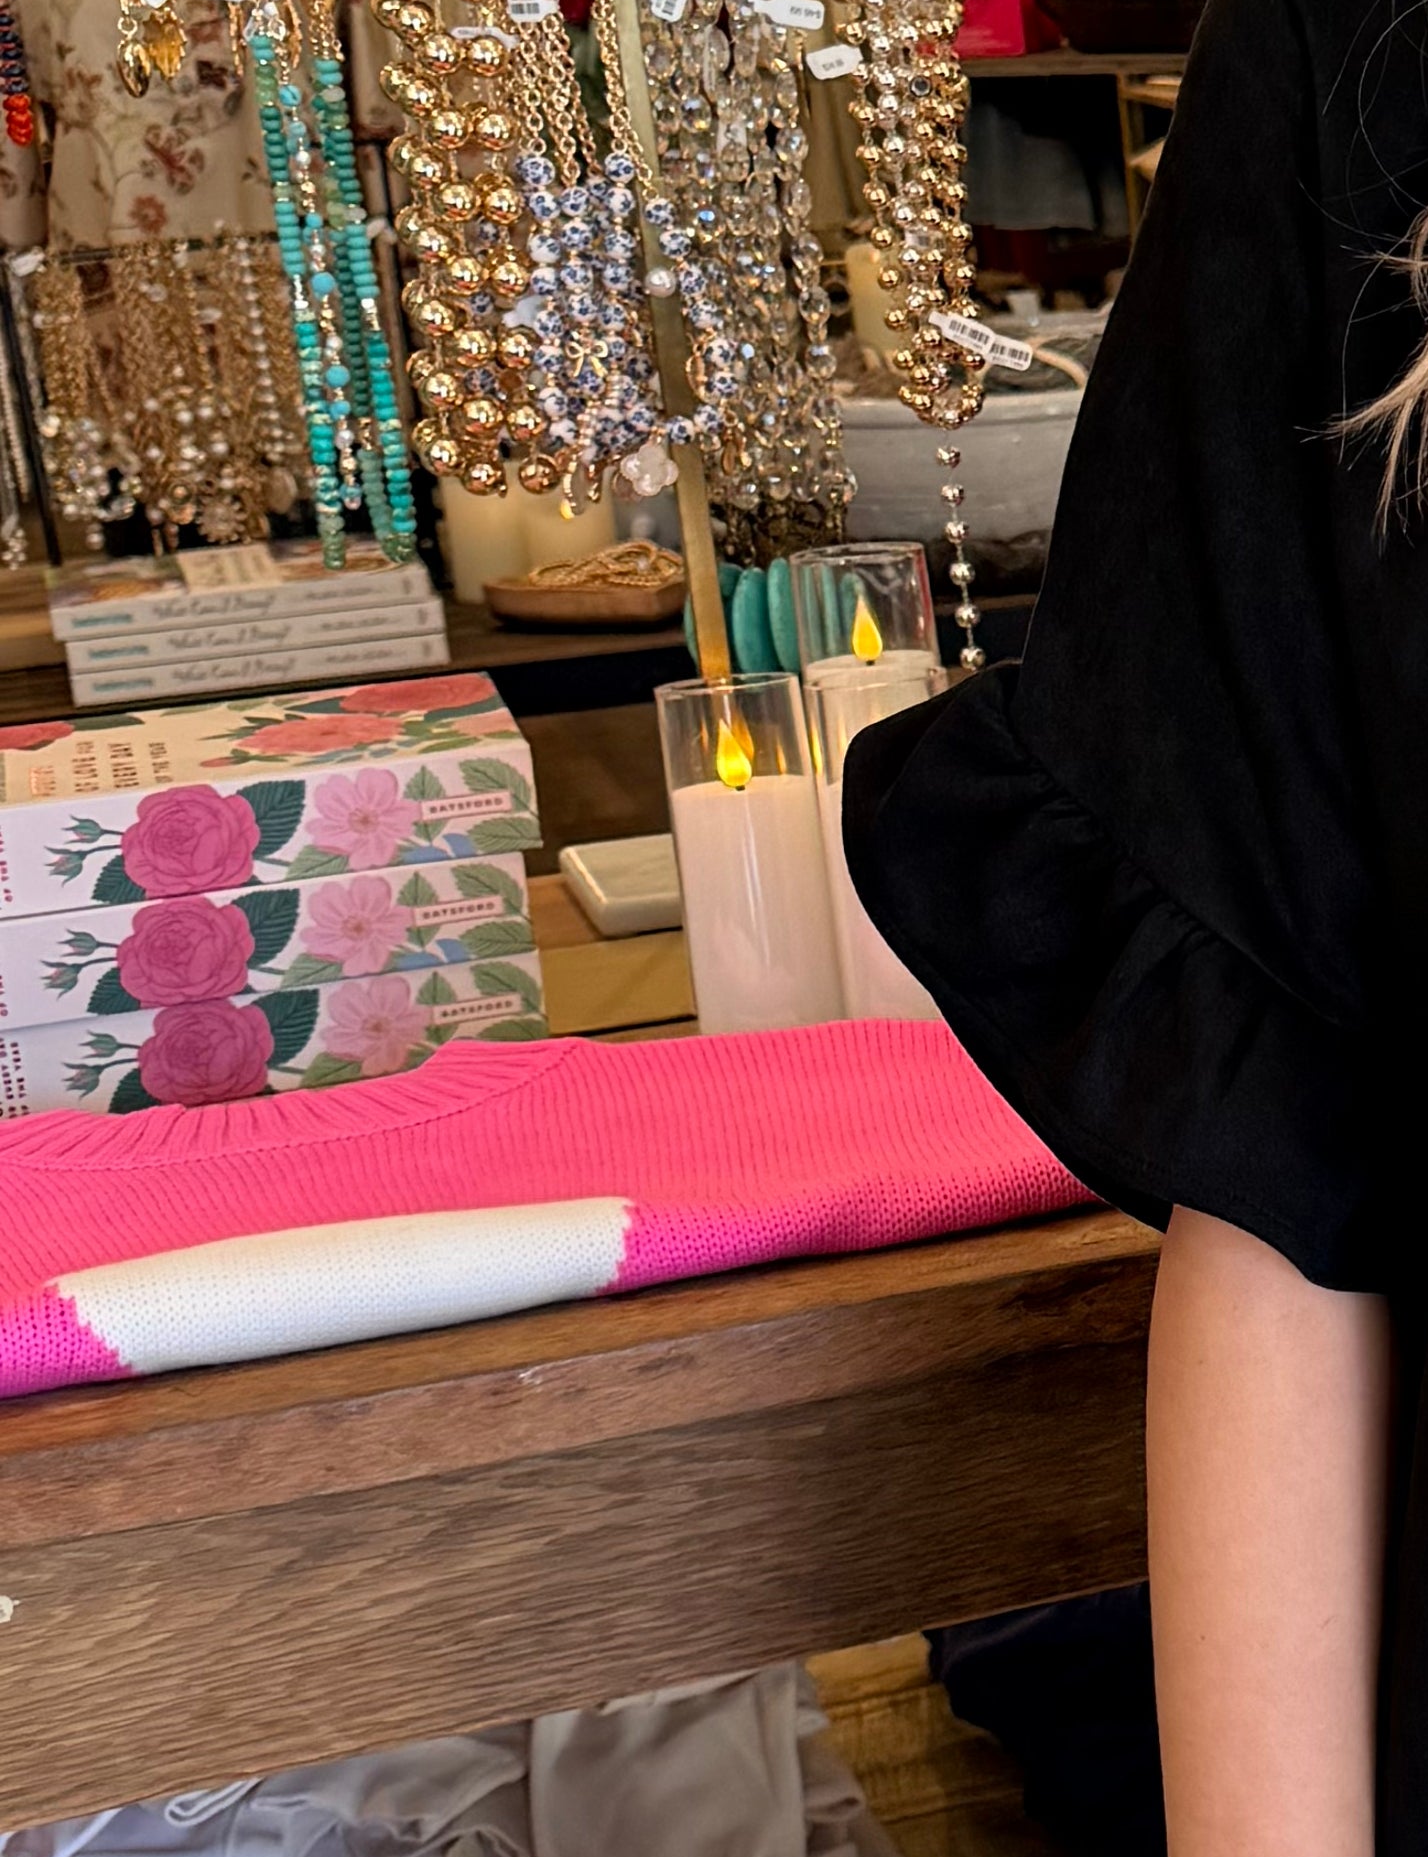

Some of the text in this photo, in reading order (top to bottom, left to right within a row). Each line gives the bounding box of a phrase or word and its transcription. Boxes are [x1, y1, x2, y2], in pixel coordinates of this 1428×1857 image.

[108, 743, 139, 788] EVERY DAY
[429, 797, 503, 814] BATSFORD
[422, 902, 495, 919] BATSFORD
[441, 1000, 513, 1018] BATSFORD
